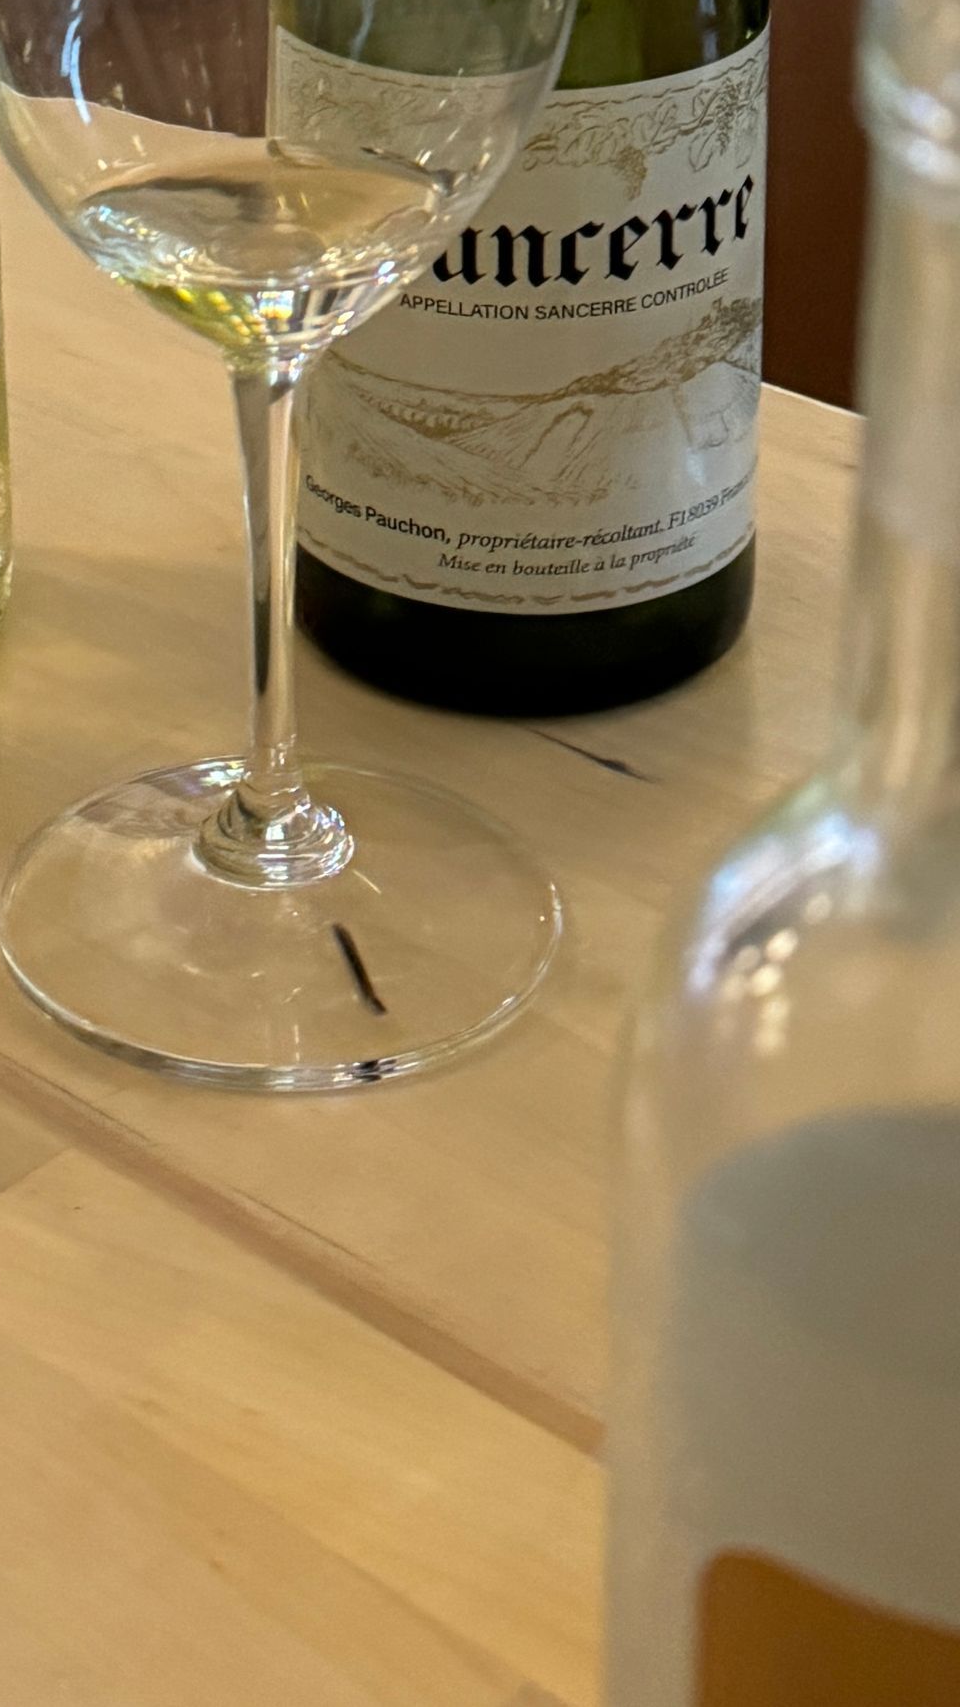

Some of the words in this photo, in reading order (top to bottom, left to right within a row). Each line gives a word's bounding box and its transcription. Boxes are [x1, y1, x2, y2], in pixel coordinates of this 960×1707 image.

[432, 174, 754, 288] ancerre
[399, 292, 529, 320] APPELLATION
[534, 296, 637, 321] SANCERRE
[304, 474, 363, 518] Georges
[365, 505, 452, 545] Pauchon,
[437, 553, 482, 573] Mise
[485, 560, 507, 575] en
[512, 558, 590, 576] bouteille
[609, 554, 627, 570] la
[332, 922, 387, 1016] 1
